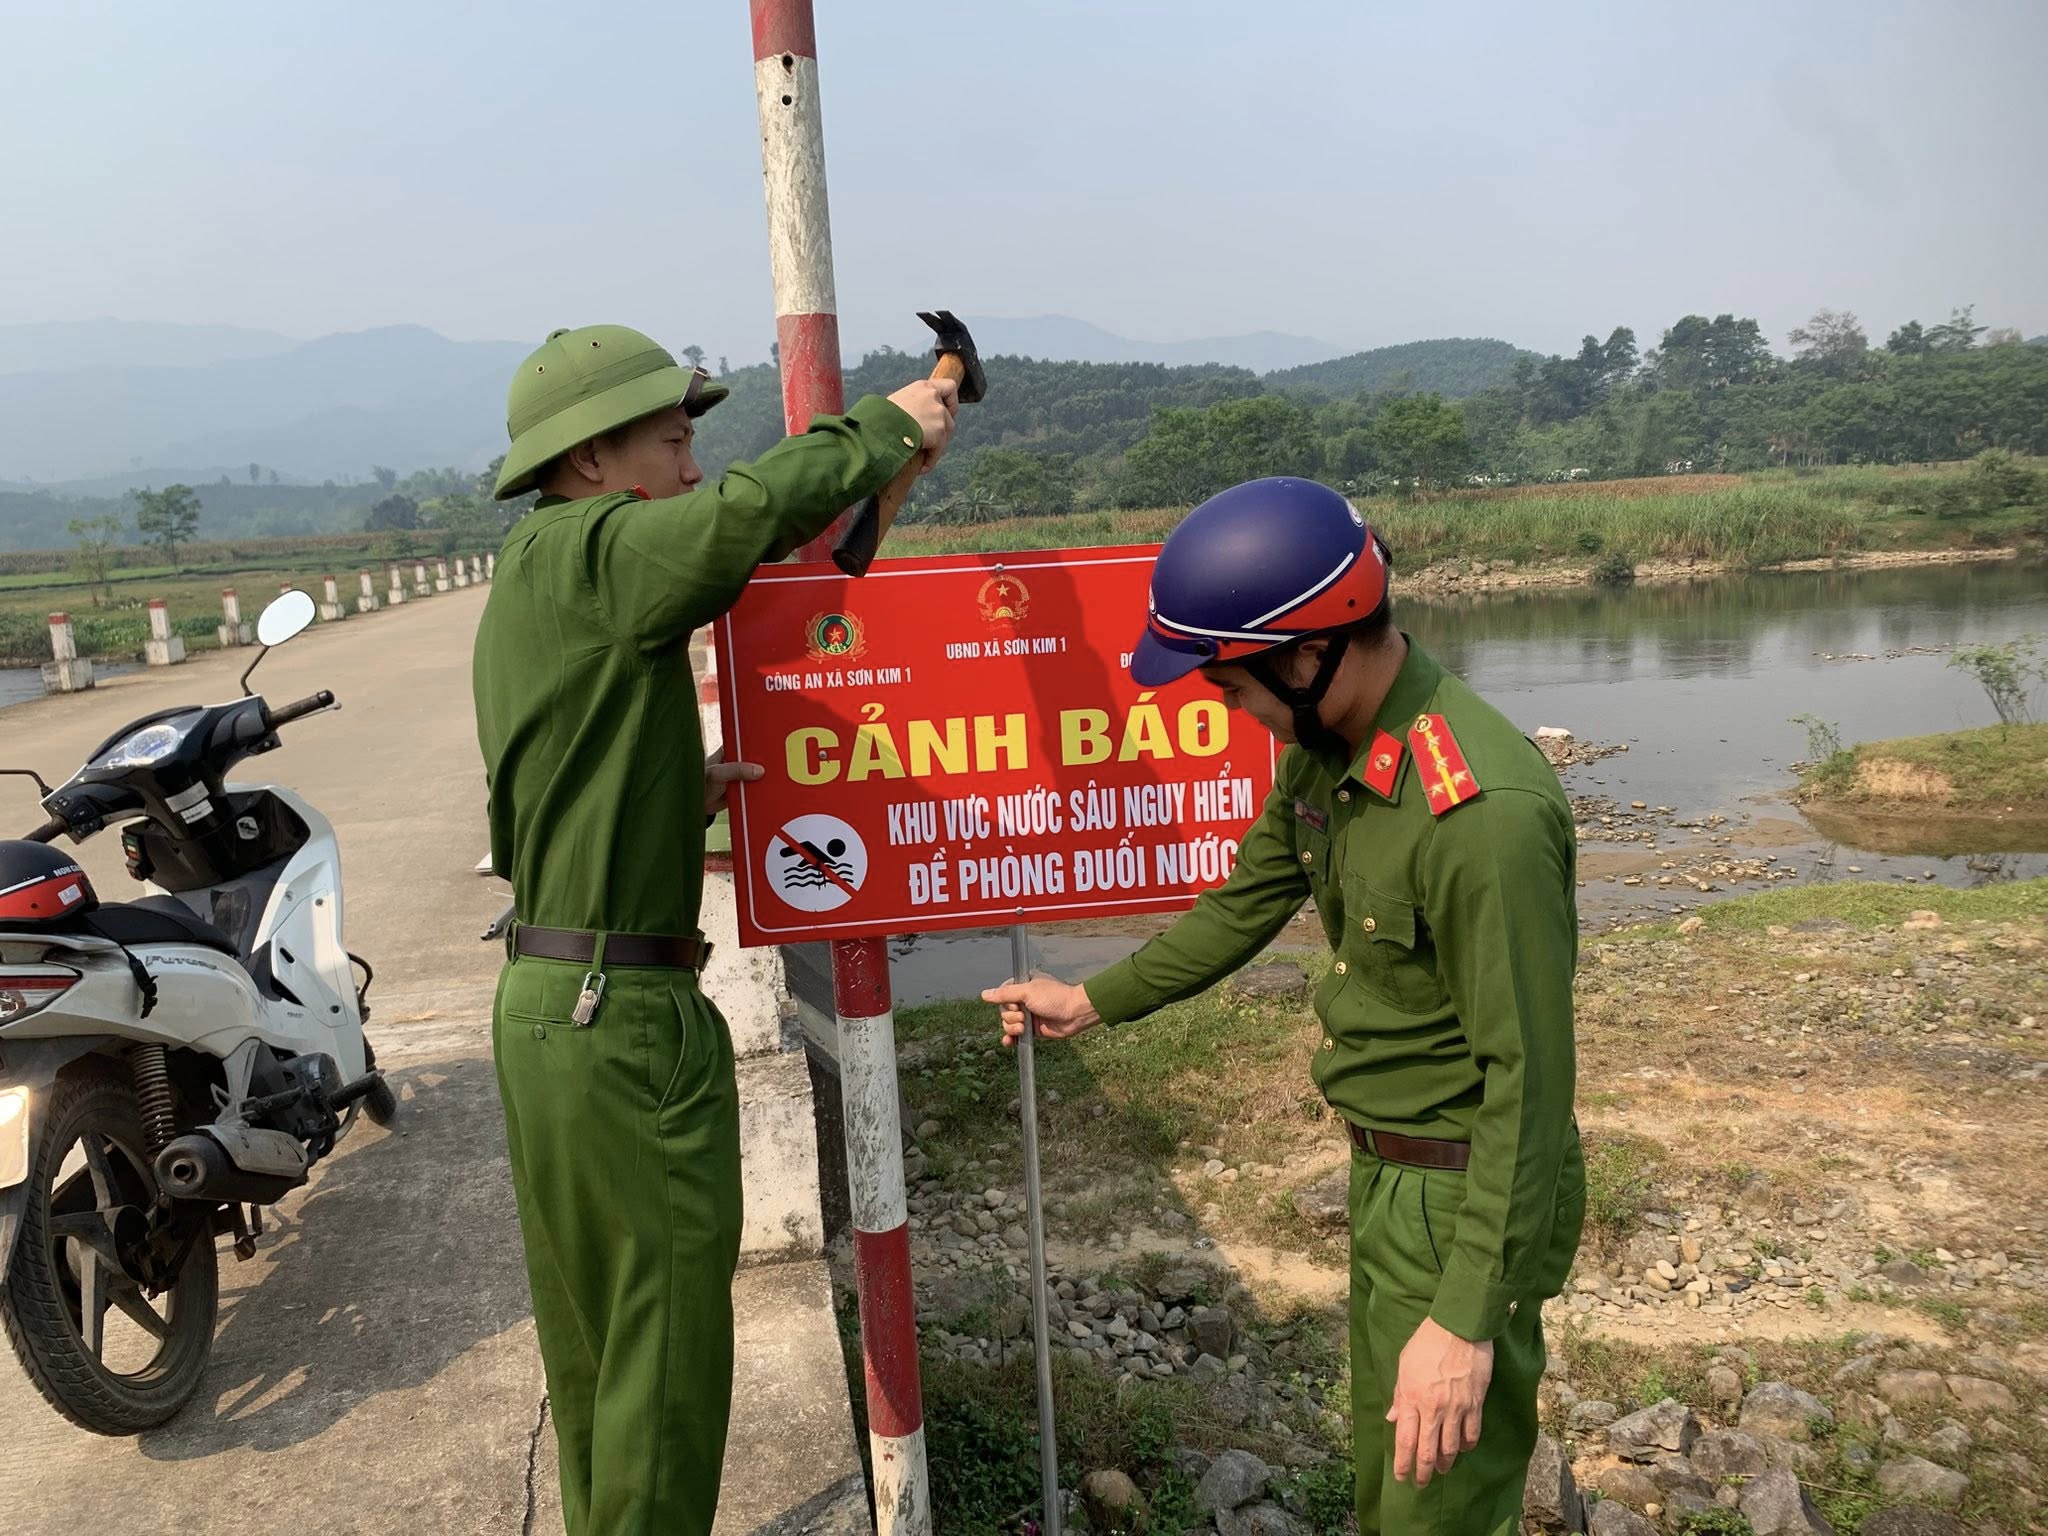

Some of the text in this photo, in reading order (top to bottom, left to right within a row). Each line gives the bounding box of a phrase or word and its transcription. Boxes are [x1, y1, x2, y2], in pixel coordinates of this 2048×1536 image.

[765, 666, 912, 692] CÔNG AN XÃ SƠN KIM 1
[945, 636, 1067, 660] UBND XÃ SƠN KIM 1
[785, 691, 1230, 785] CẢNH BÁO
[887, 802, 937, 846] KHU
[943, 793, 991, 850] VỰC
[997, 783, 1063, 838] NƯỚC
[1069, 779, 1117, 833] SÂU
[1124, 782, 1186, 828] NGUY
[1193, 761, 1254, 822] HIỂM
[908, 831, 1239, 905] ĐỀ PHÒNG ĐUỐI NƯỚC
